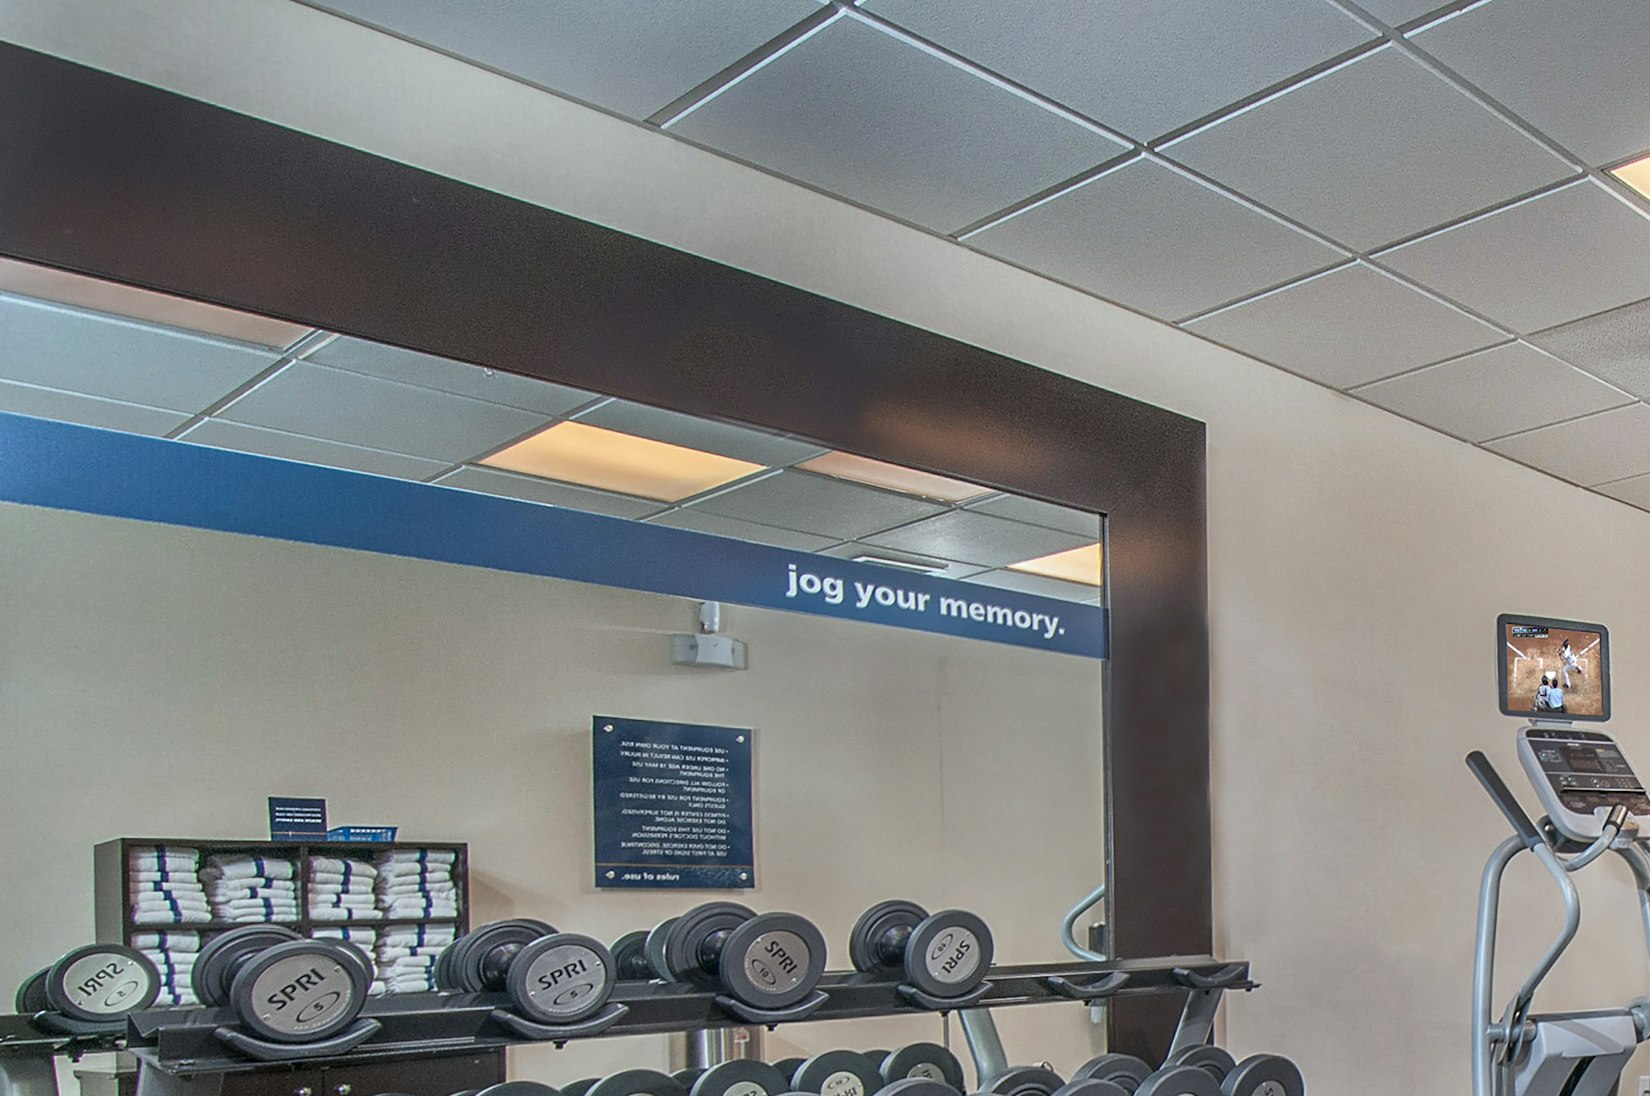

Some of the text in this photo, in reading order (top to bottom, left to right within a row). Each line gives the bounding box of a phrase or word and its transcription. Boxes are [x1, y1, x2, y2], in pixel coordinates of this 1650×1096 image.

[785, 563, 1065, 638] jog your memory.
[760, 968, 770, 977] 10
[765, 941, 797, 974] SPRI
[942, 940, 970, 973] SPRI
[267, 967, 327, 1011] SPRI
[537, 959, 589, 991] SPRI
[313, 1002, 324, 1012] 5
